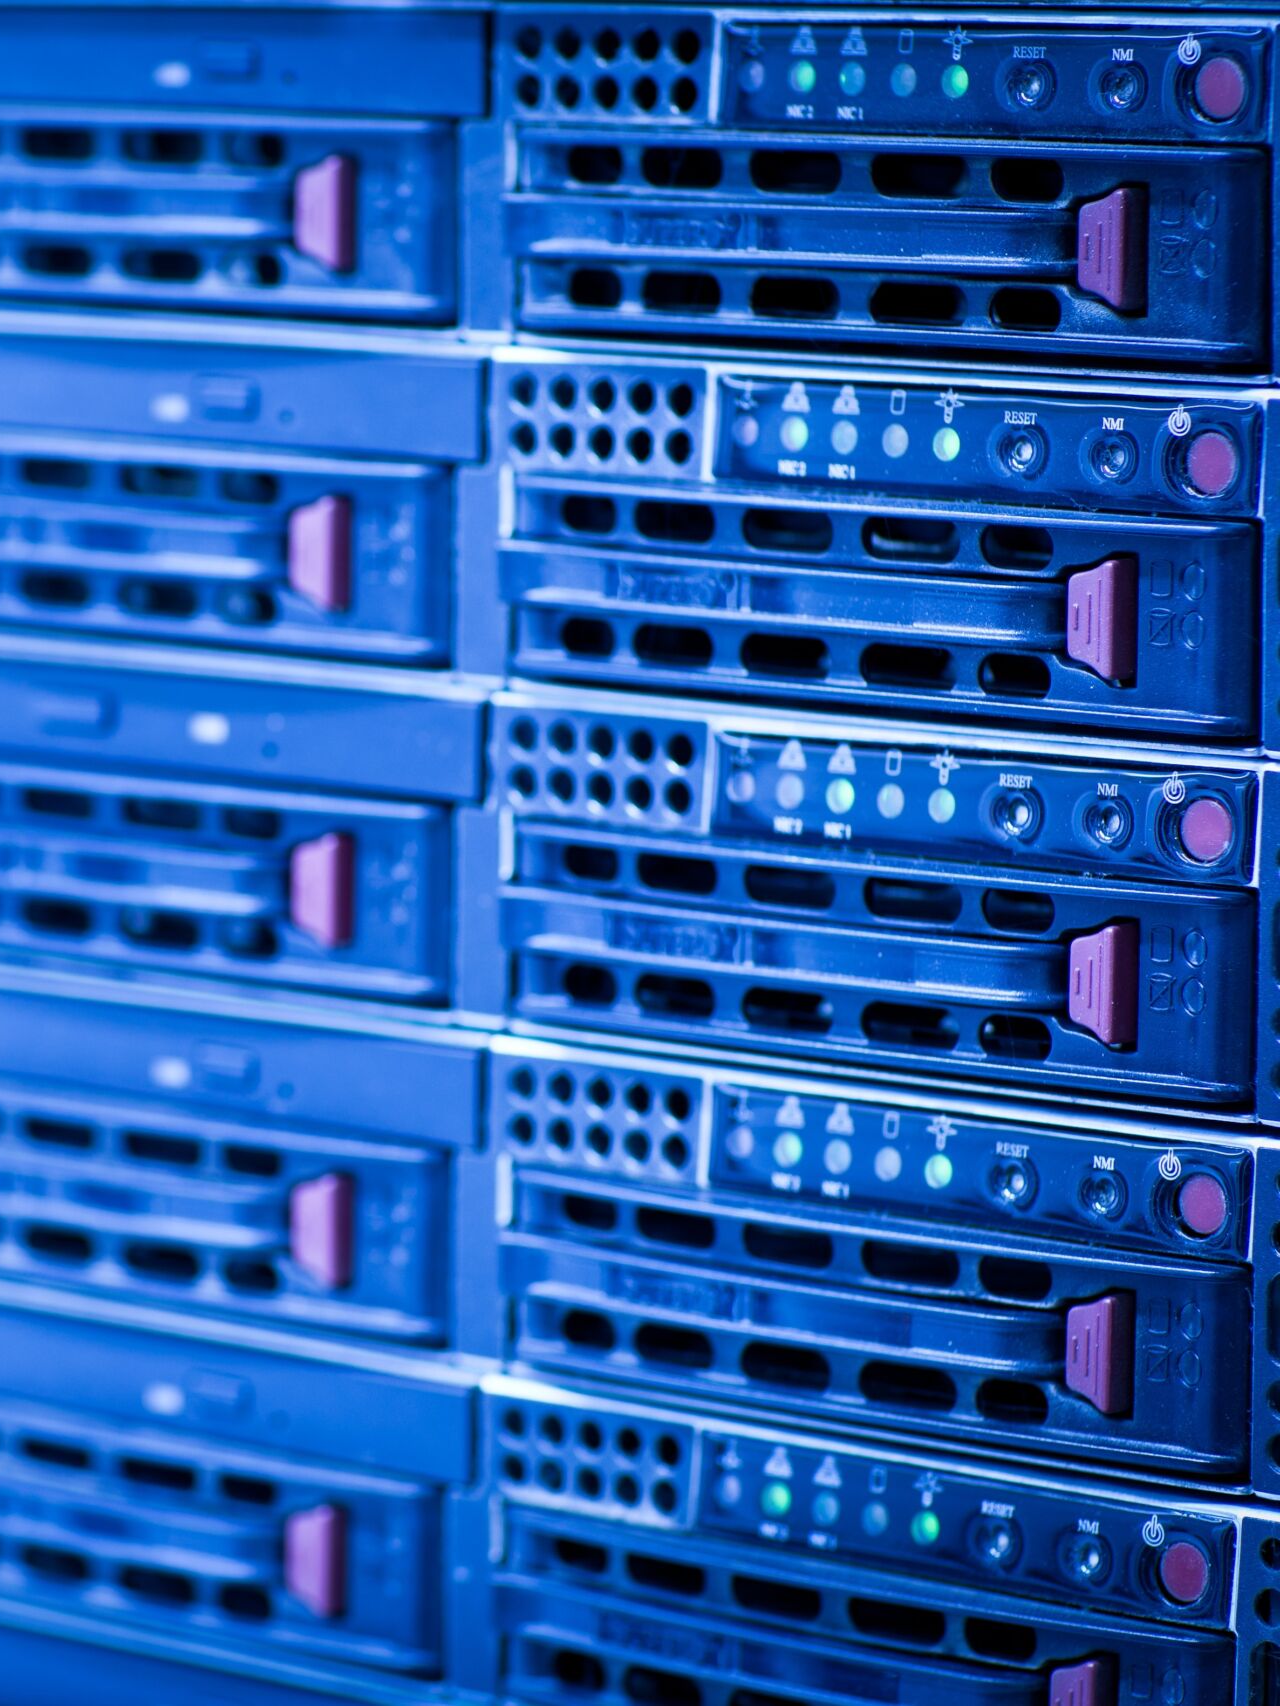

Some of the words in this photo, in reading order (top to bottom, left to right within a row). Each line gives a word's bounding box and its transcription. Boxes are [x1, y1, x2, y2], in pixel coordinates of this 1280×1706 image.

[1013, 46, 1047, 59] RESET
[1112, 48, 1134, 61] NMI
[1004, 411, 1037, 425] RESET
[1102, 417, 1124, 430] NMI
[999, 773, 1033, 789] RESET
[1097, 782, 1119, 796] NMI
[996, 1142, 1029, 1158] RESET
[1093, 1155, 1115, 1170] NMI
[1077, 1518, 1099, 1534] NMI
